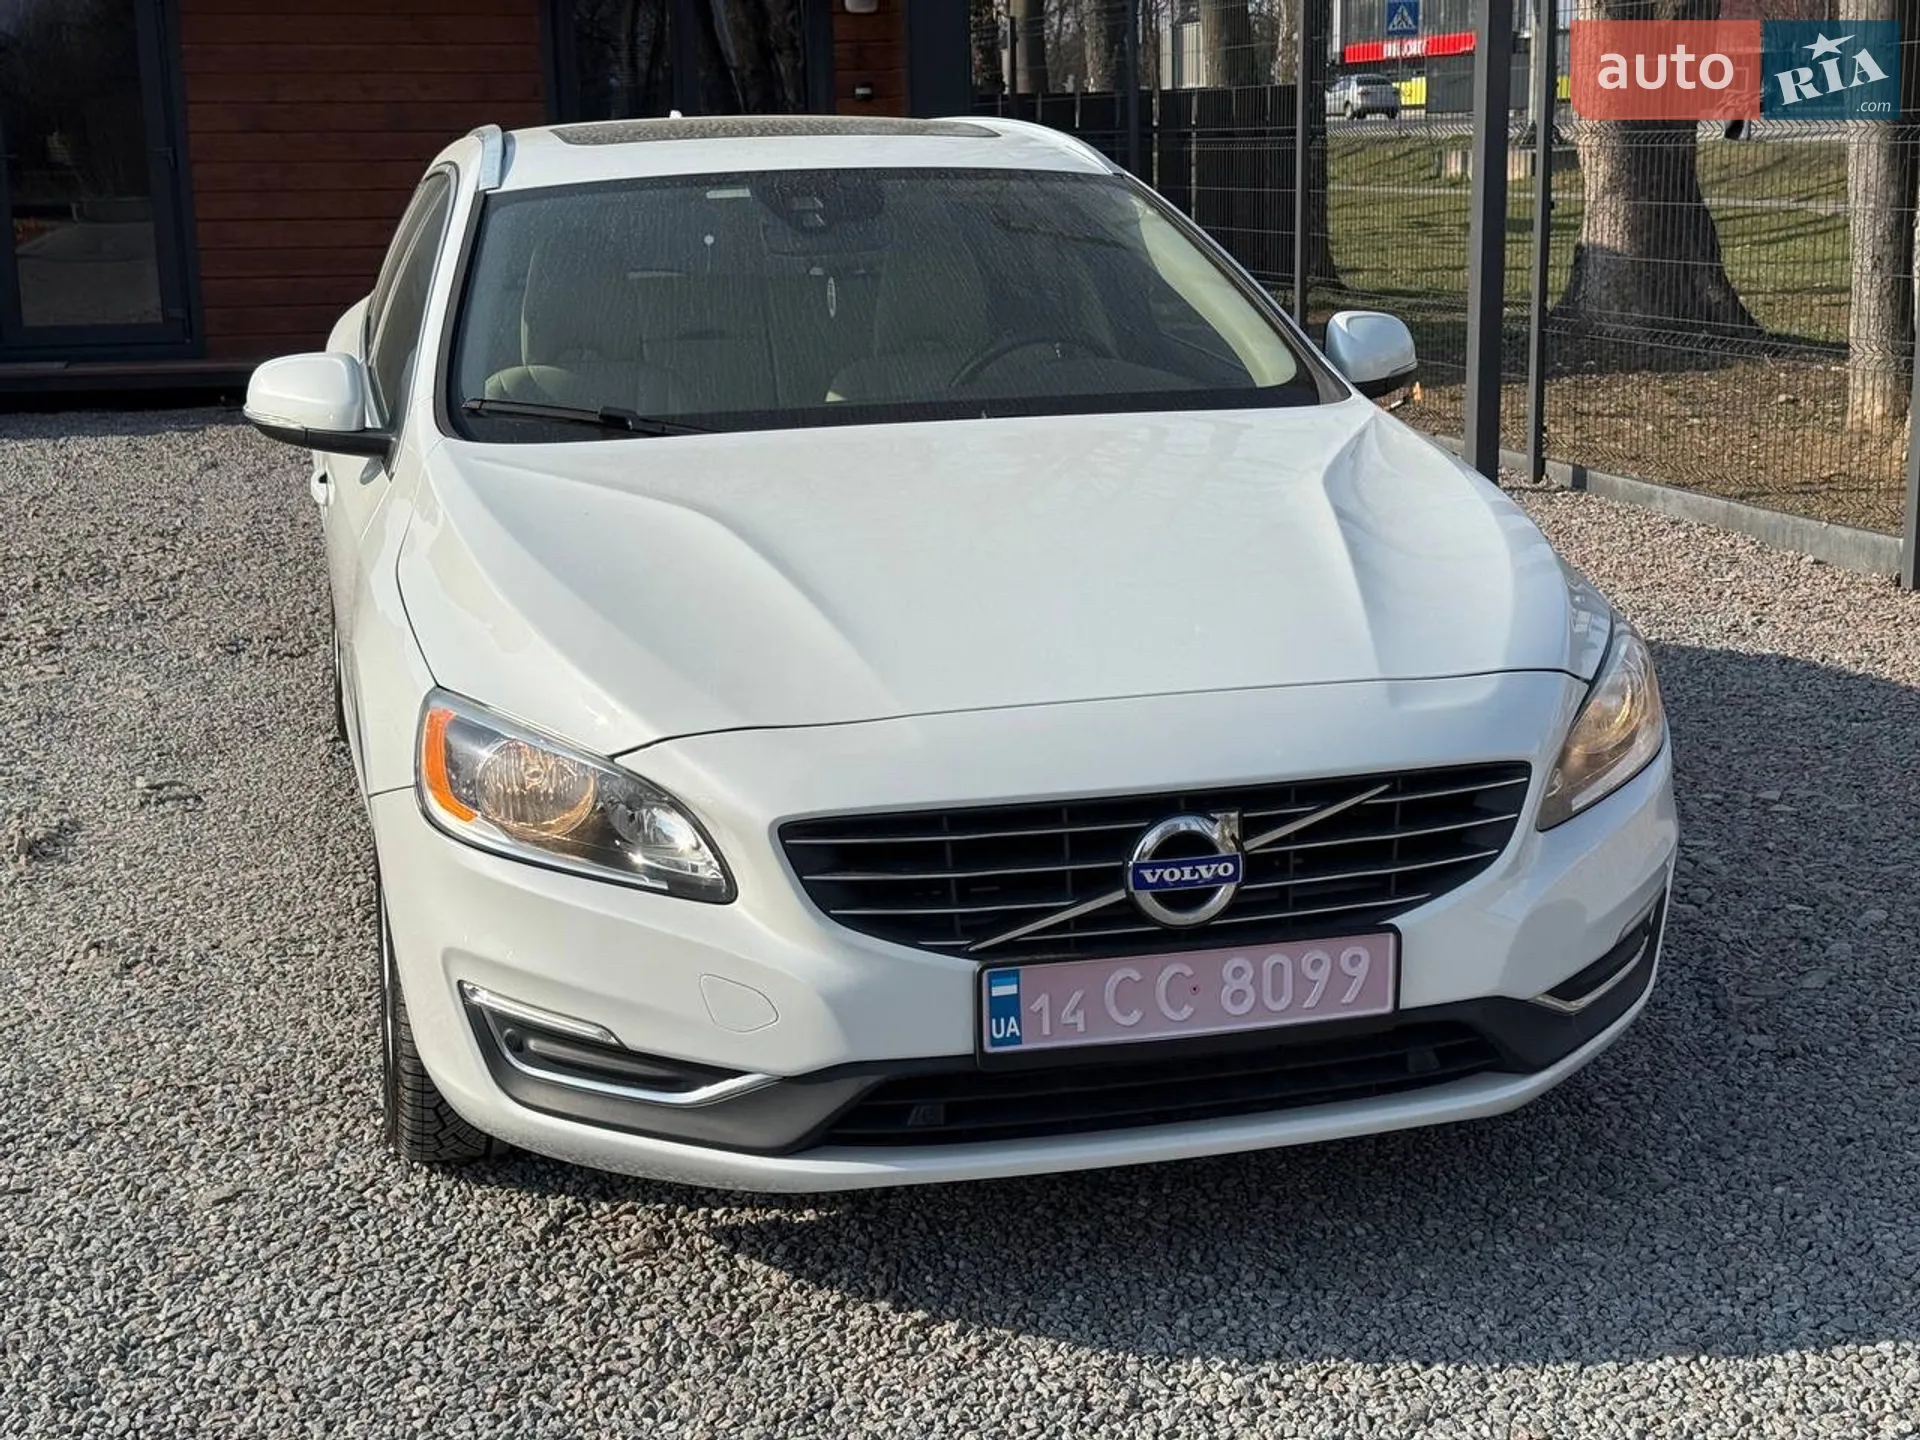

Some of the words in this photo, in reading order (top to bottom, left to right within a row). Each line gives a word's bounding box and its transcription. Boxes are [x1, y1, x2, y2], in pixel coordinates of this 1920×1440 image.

[1139, 861, 1235, 884] VOLVO
[1029, 989, 1086, 1036] 14
[1103, 962, 1195, 1027] CC
[1220, 945, 1371, 1016] 8099
[991, 1016, 1020, 1039] UA
